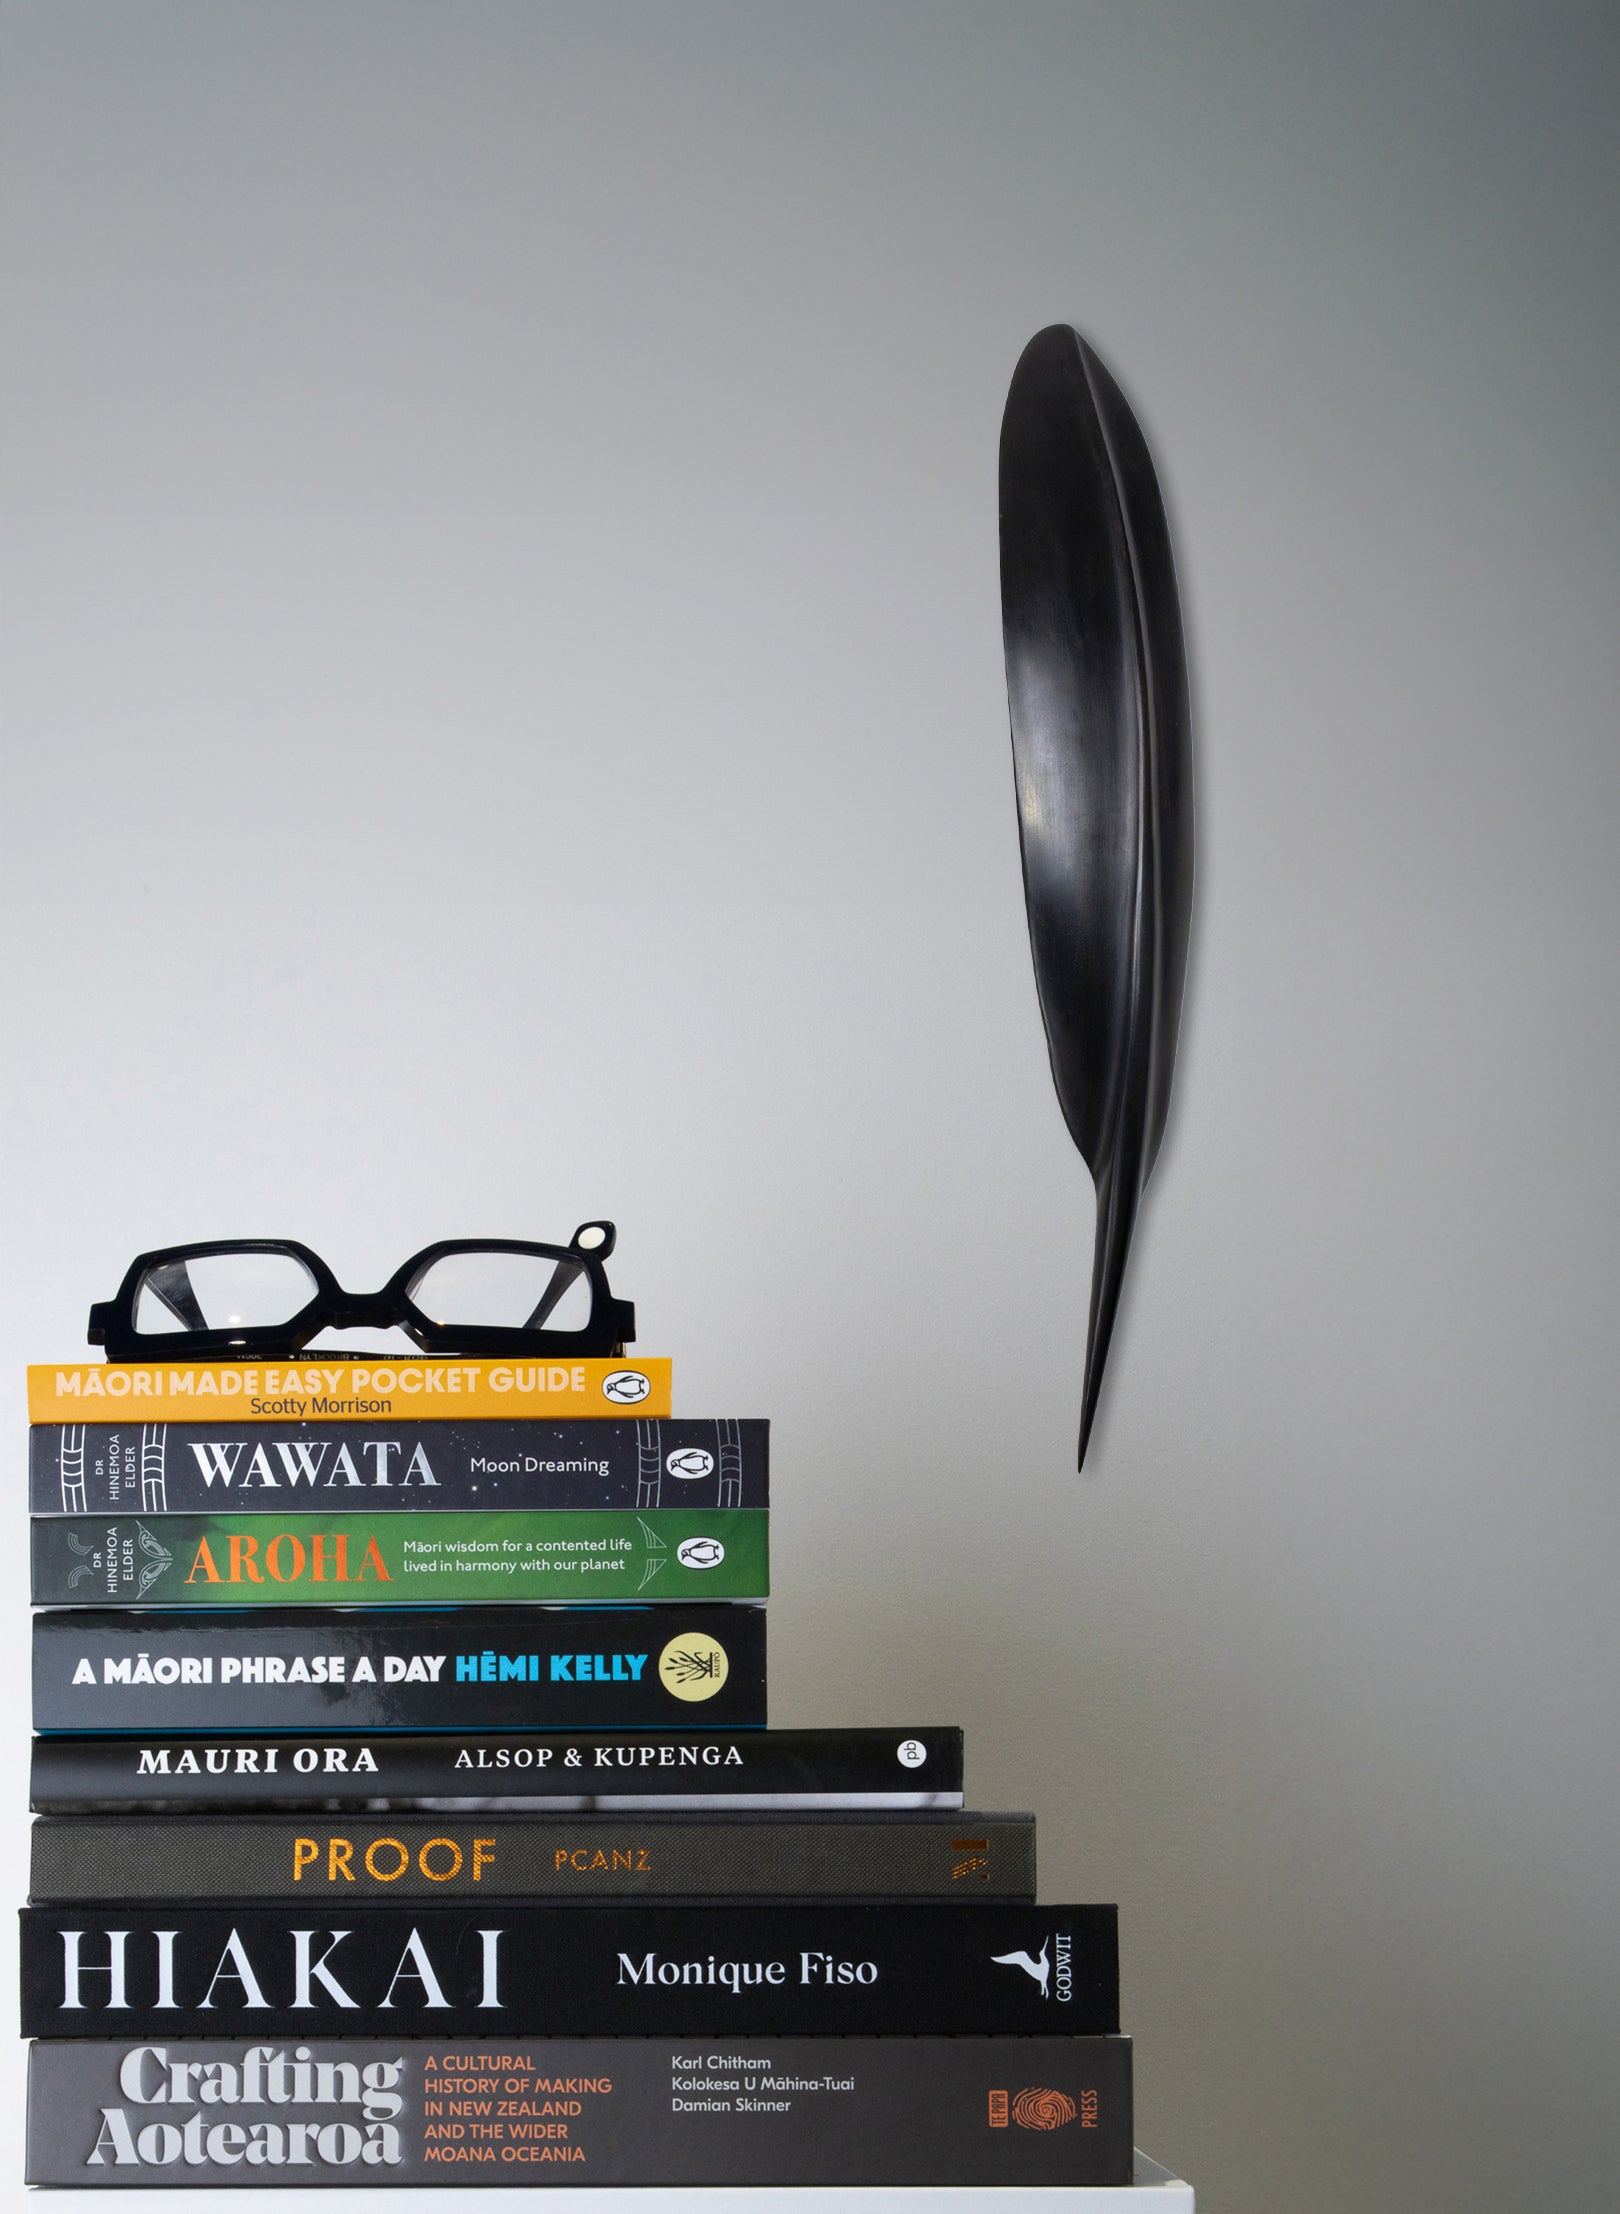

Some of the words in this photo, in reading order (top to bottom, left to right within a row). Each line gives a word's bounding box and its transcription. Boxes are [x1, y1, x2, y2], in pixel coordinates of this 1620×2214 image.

[55, 1368, 162, 1396] MĀORI
[170, 1370, 258, 1396] MADE
[266, 1369, 342, 1394] EASY
[352, 1368, 480, 1393] POCKET
[489, 1367, 585, 1392] GUIDE
[251, 1398, 307, 1416] Scotty
[312, 1397, 391, 1413] Morrison
[96, 1460, 103, 1475] DR
[109, 1435, 119, 1499] HINEMOA
[125, 1447, 135, 1487] ELDER
[187, 1442, 441, 1487] WAWATA
[471, 1457, 520, 1473] Moon
[526, 1457, 609, 1476] Dreaming
[404, 1541, 441, 1552] Māori
[445, 1541, 497, 1552] wisdom
[502, 1540, 521, 1551] for
[526, 1543, 532, 1552] a
[536, 1541, 606, 1552] contented
[610, 1539, 632, 1551] life
[93, 1553, 101, 1567] DR
[107, 1527, 117, 1592] HINEMOA
[123, 1539, 133, 1580] ELDER
[186, 1534, 392, 1583] AROHA
[404, 1560, 436, 1572] lived
[441, 1560, 452, 1571] in
[456, 1560, 517, 1574] harmony
[520, 1559, 549, 1570] with
[554, 1562, 577, 1570] our
[581, 1558, 625, 1573] planet
[72, 1659, 96, 1684] A
[104, 1653, 212, 1684] MĀORI
[221, 1656, 345, 1683] PHRASE
[352, 1657, 377, 1682] A
[384, 1656, 446, 1682] DAY
[456, 1651, 538, 1681] HĒMI
[551, 1655, 648, 1681] KELLY
[137, 1749, 278, 1774] MAURI
[293, 1748, 378, 1772] ORA
[455, 1749, 552, 1768] ALSOP
[564, 1748, 582, 1766] &
[595, 1746, 743, 1766] KUPENGA
[294, 1838, 495, 1881] PROOF
[555, 1850, 650, 1870] PCANZ
[59, 1928, 503, 2008] HIAKAI
[618, 1953, 785, 1993] Monique
[800, 1953, 877, 1984] Fiso
[1056, 1934, 1071, 2001] GODWIT
[425, 2056, 437, 2071] A
[442, 2055, 535, 2071] CULTURAL
[672, 2056, 701, 2069] Karl
[707, 2056, 771, 2069] Chitham
[120, 2047, 402, 2122] Crafting
[425, 2078, 499, 2094] HISTORY
[505, 2078, 529, 2093] OF
[535, 2078, 612, 2093] MAKING
[673, 2077, 739, 2090] Kolokesa
[745, 2077, 755, 2090] U
[761, 2077, 854, 2090] Māhina-Tuai
[425, 2102, 443, 2116] IN
[449, 2101, 492, 2116] NEW
[497, 2100, 582, 2116] ZEALAND
[673, 2098, 730, 2111] Damian
[736, 2098, 791, 2111] Skinner
[991, 2093, 1006, 2113] PAPA
[1081, 2090, 1098, 2128] PRESS
[991, 2115, 1006, 2126] TE
[86, 2109, 402, 2164] Aotearoa
[424, 2124, 464, 2139] AND
[470, 2124, 503, 2139] THE
[509, 2124, 568, 2139] WIDER
[424, 2146, 496, 2162] MOANA
[501, 2146, 585, 2162] OCEANIA
